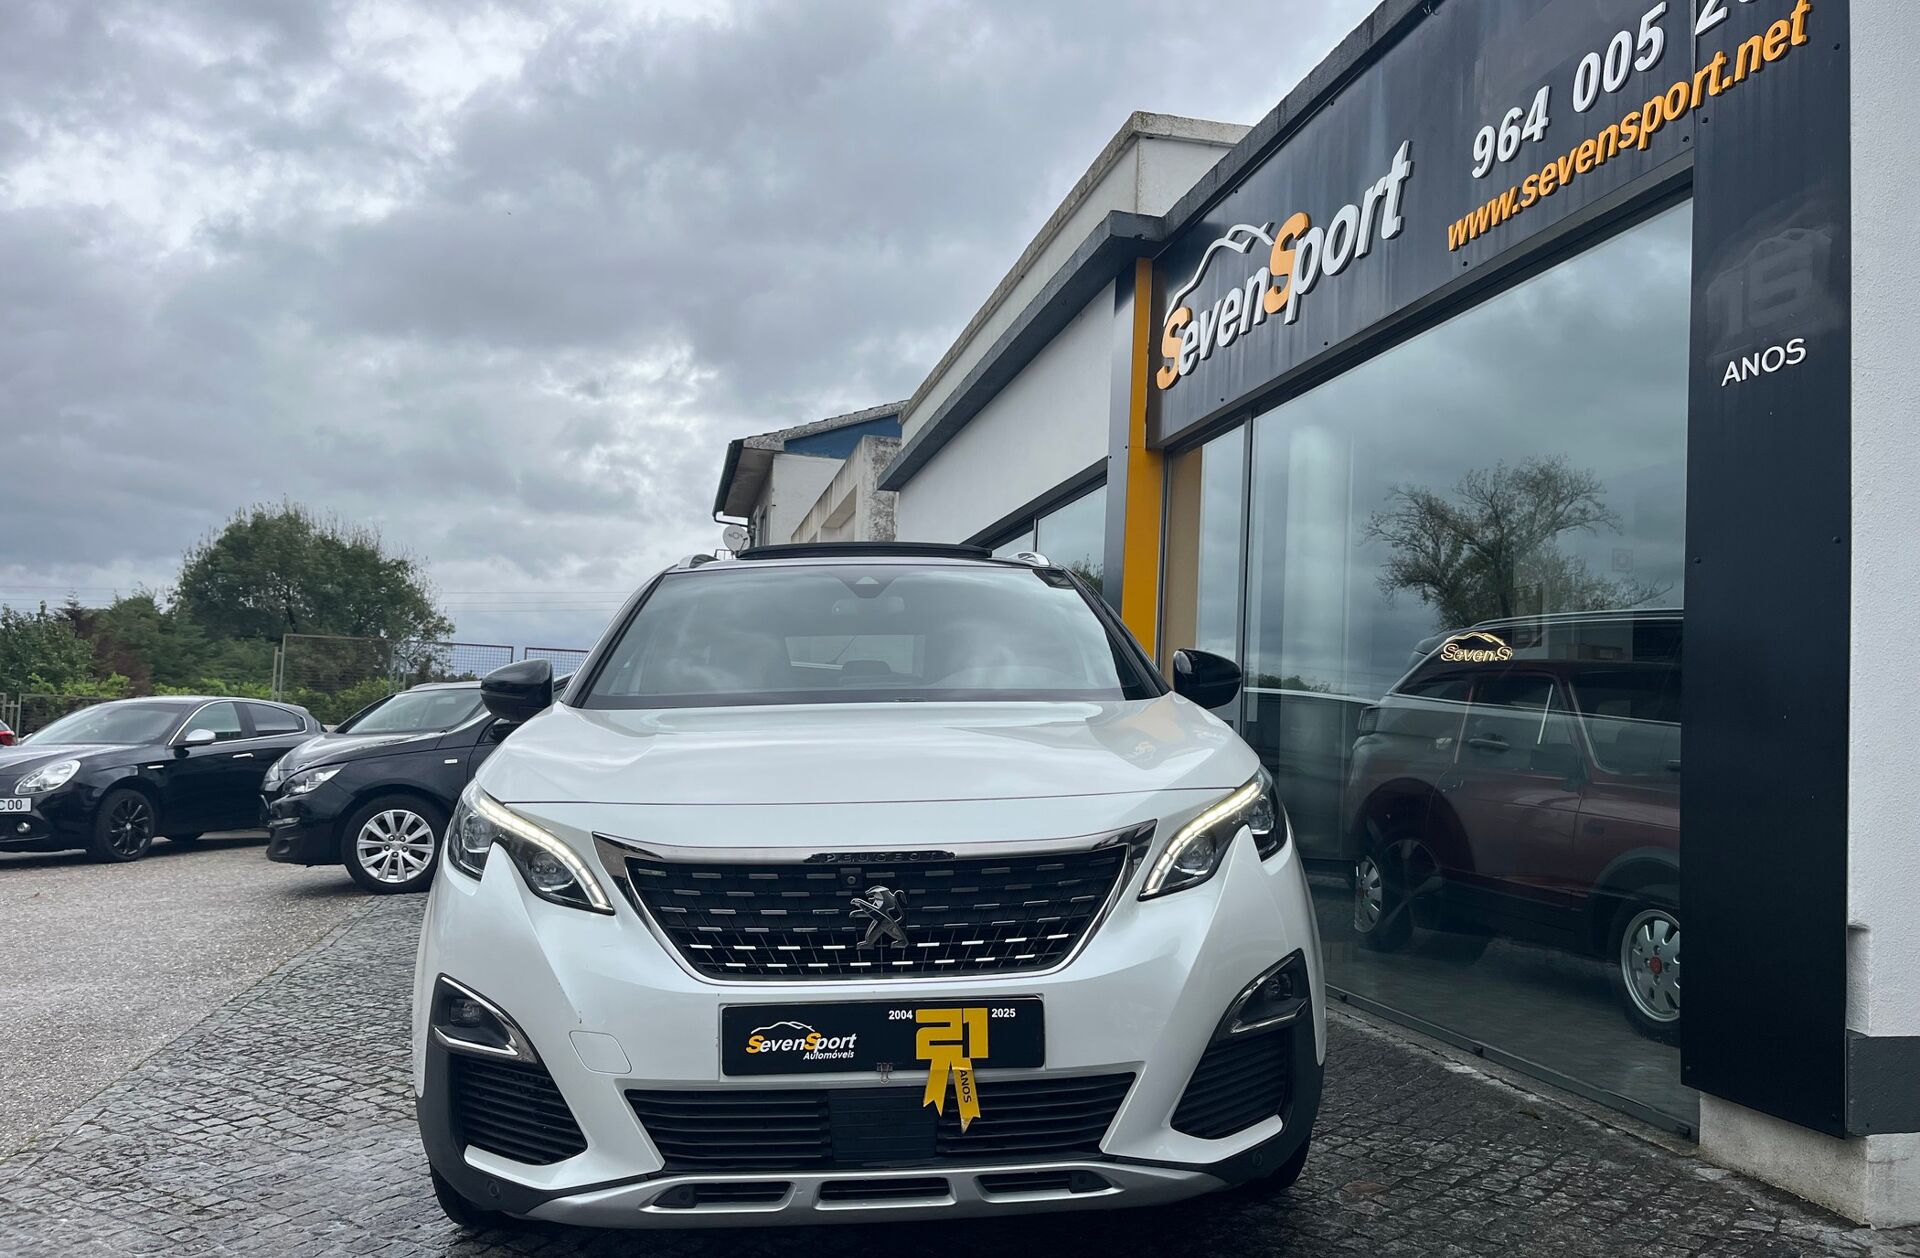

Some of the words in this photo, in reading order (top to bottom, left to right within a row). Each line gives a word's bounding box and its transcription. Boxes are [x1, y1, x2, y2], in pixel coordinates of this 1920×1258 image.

[1471, 85, 1551, 179] 964
[1572, 1, 1667, 113] 005
[1448, 0, 1811, 252] www.sevensport.net
[1156, 140, 1411, 390] SevenSport
[1721, 338, 1807, 387] ANOS
[1440, 643, 1513, 663] SevenS
[825, 851, 939, 864] PEUGEOT
[745, 1032, 858, 1054] SevenSport
[803, 1049, 855, 1060] Automóveis
[888, 1010, 913, 1020] 2004
[916, 1008, 989, 1060] 21
[991, 1008, 1016, 1018] 2025
[959, 1069, 972, 1104] ANOS
